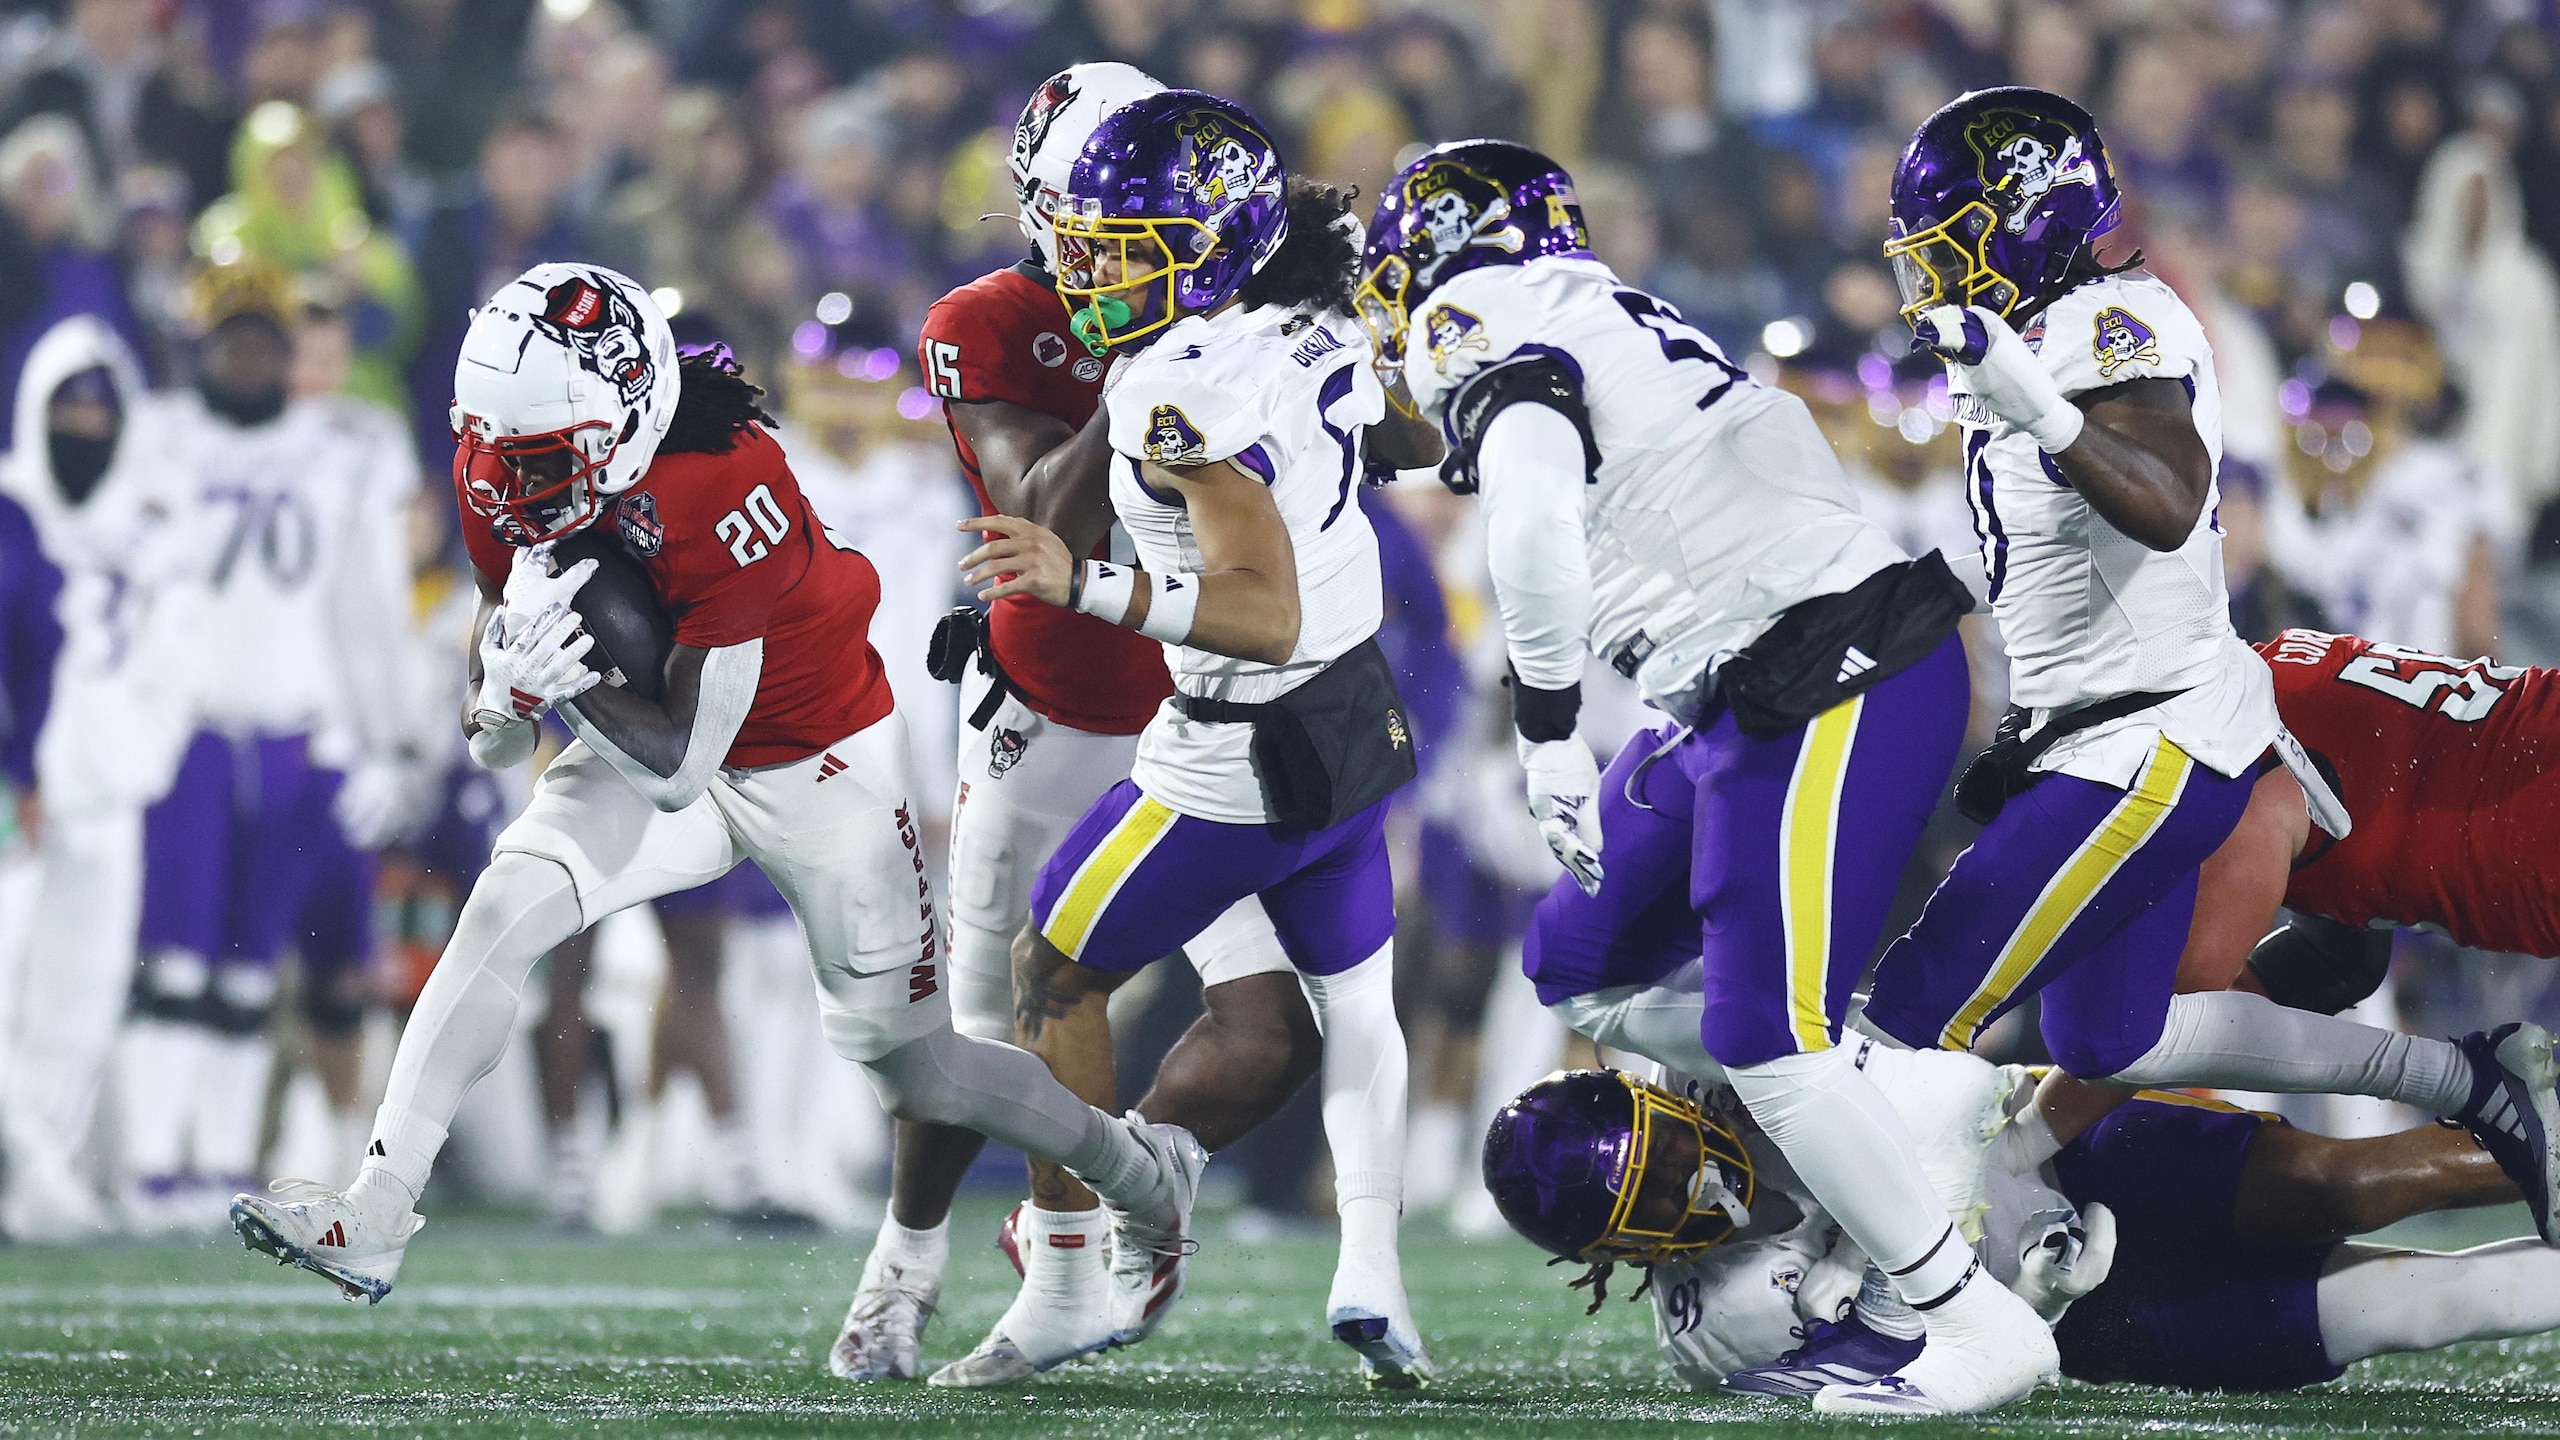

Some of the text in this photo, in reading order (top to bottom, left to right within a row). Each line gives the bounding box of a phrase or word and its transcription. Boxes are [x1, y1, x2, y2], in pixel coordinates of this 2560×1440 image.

[1193, 119, 1223, 148] ECU
[1982, 117, 2015, 148] ECU
[1416, 171, 1448, 198] ECU
[565, 289, 597, 326] NC STATE
[2102, 315, 2123, 330] ECU
[924, 336, 962, 400] 15
[1079, 361, 1099, 374] ACC
[1156, 415, 1177, 427] ECU
[203, 487, 319, 595] 70
[714, 483, 791, 569] 20
[1669, 1277, 1703, 1336] 93
